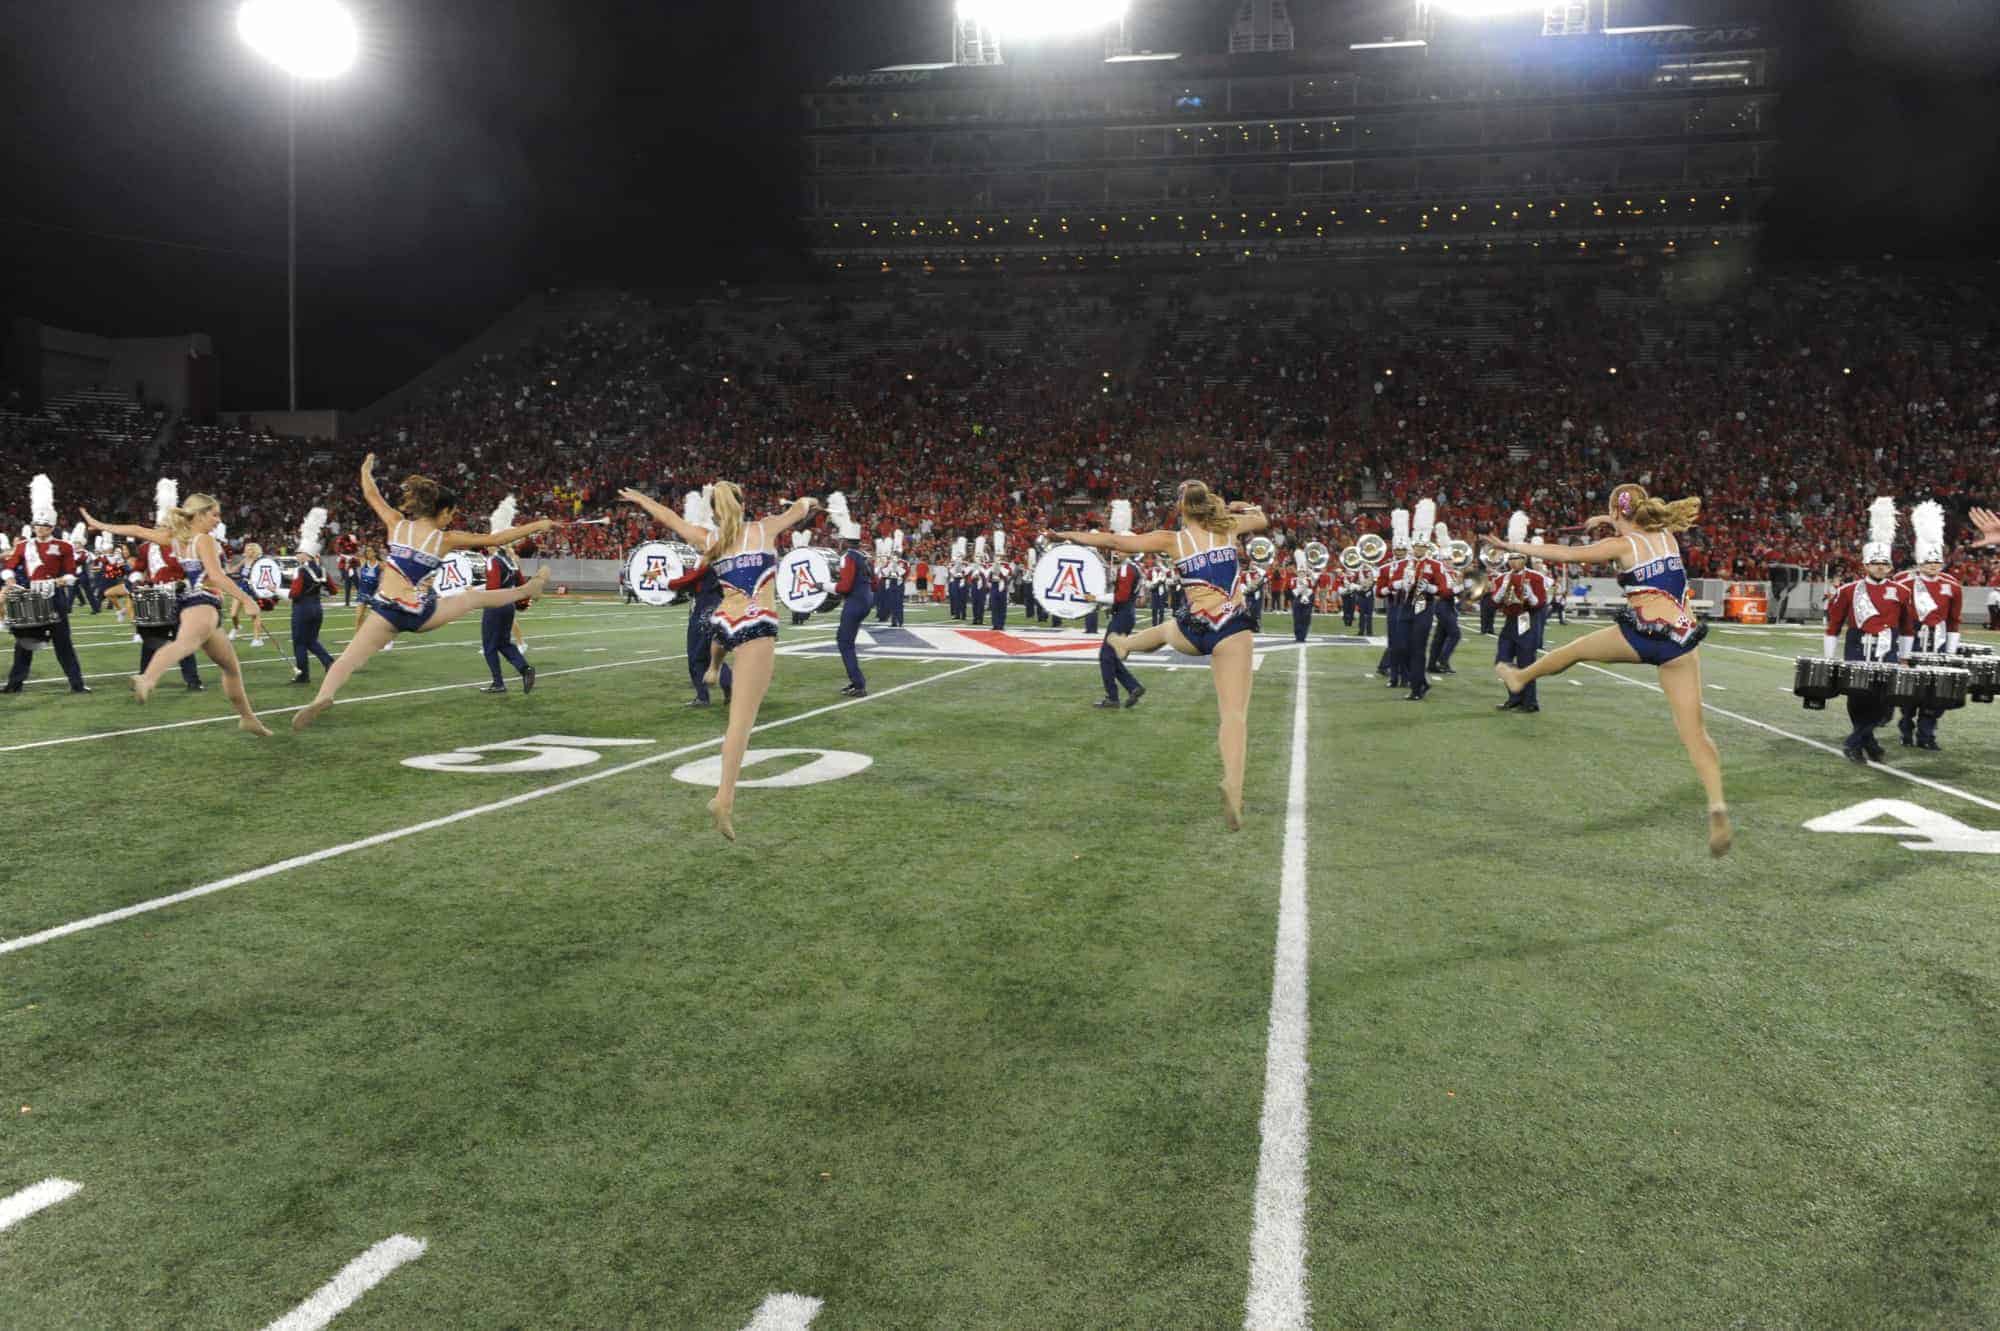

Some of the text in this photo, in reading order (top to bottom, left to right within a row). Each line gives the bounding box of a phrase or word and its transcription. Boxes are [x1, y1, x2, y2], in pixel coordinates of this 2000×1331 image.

[256, 565, 277, 589] A
[440, 559, 467, 591] A
[640, 556, 671, 591] A
[789, 560, 820, 600] A
[1045, 559, 1095, 602] A
[1633, 560, 1664, 581] WILD
